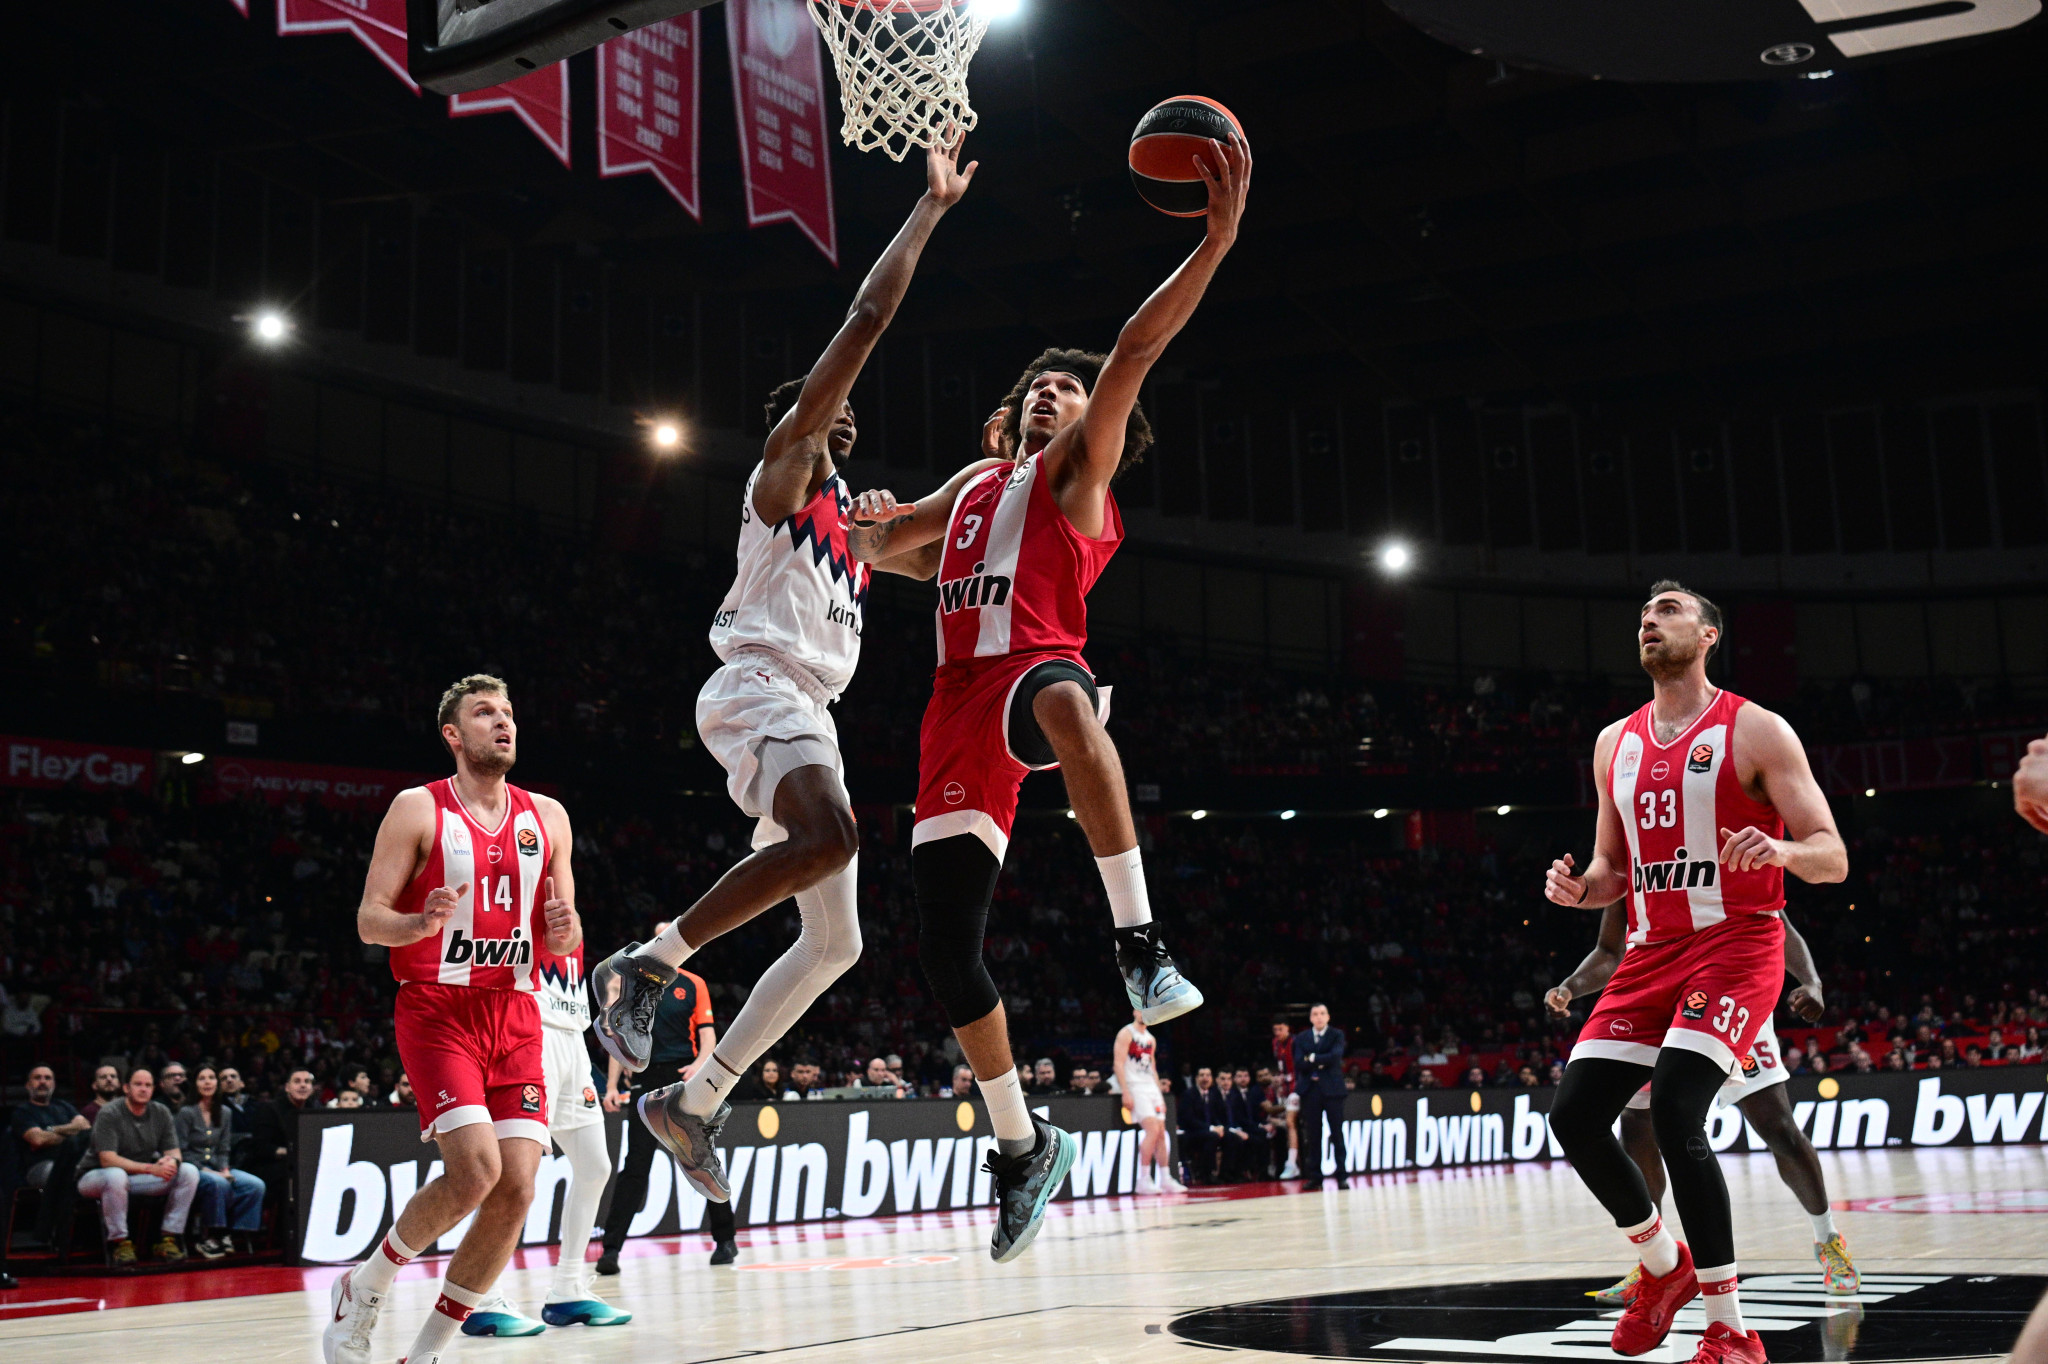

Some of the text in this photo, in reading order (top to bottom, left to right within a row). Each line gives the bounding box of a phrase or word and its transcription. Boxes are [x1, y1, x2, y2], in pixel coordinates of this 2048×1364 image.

[956, 514, 983, 550] 3
[937, 562, 1012, 615] win
[252, 775, 330, 793] NEVER
[334, 781, 386, 798] QUIT
[1639, 789, 1677, 830] 33
[1634, 847, 1717, 893] bwin
[481, 875, 513, 912] 14
[444, 927, 533, 966] bwin
[1712, 995, 1750, 1045] 33
[1415, 1091, 1505, 1168] bwin
[302, 1124, 574, 1263] bn
[1717, 1280, 1737, 1293] GS
